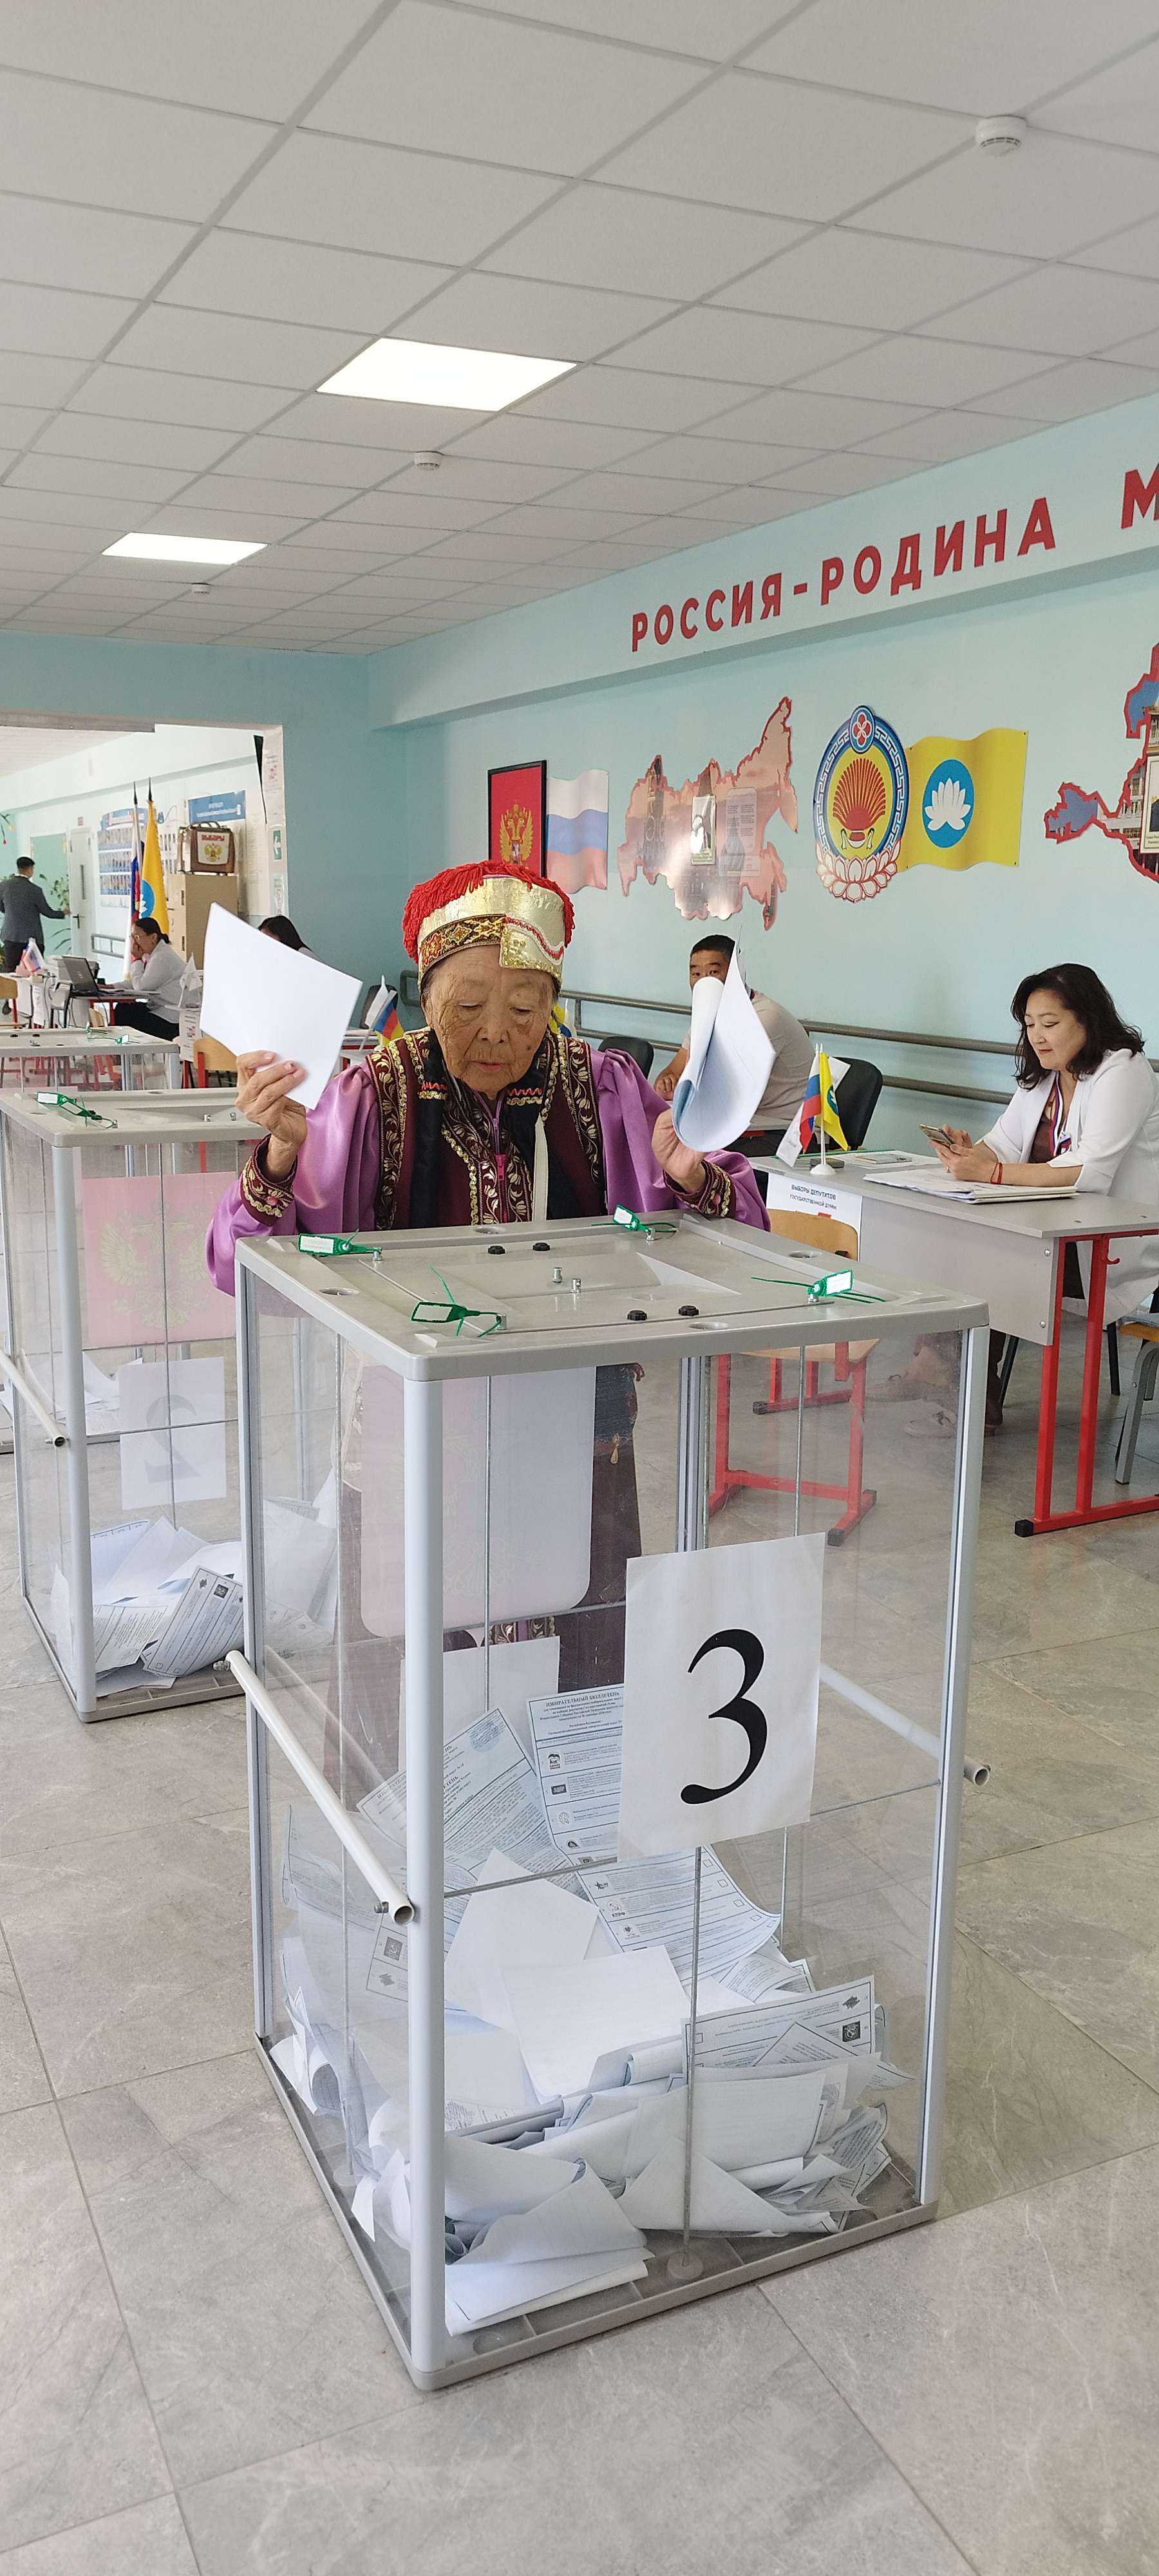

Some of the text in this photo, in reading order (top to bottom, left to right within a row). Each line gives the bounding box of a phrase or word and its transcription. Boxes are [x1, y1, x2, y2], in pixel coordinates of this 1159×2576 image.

[791, 1184, 836, 1200] ВЫБОРЫ ДЕПУТАТОВ
[789, 1194, 825, 1207] ГОСУДАРСТВЕННОЙ
[680, 1629, 768, 1804] 3
